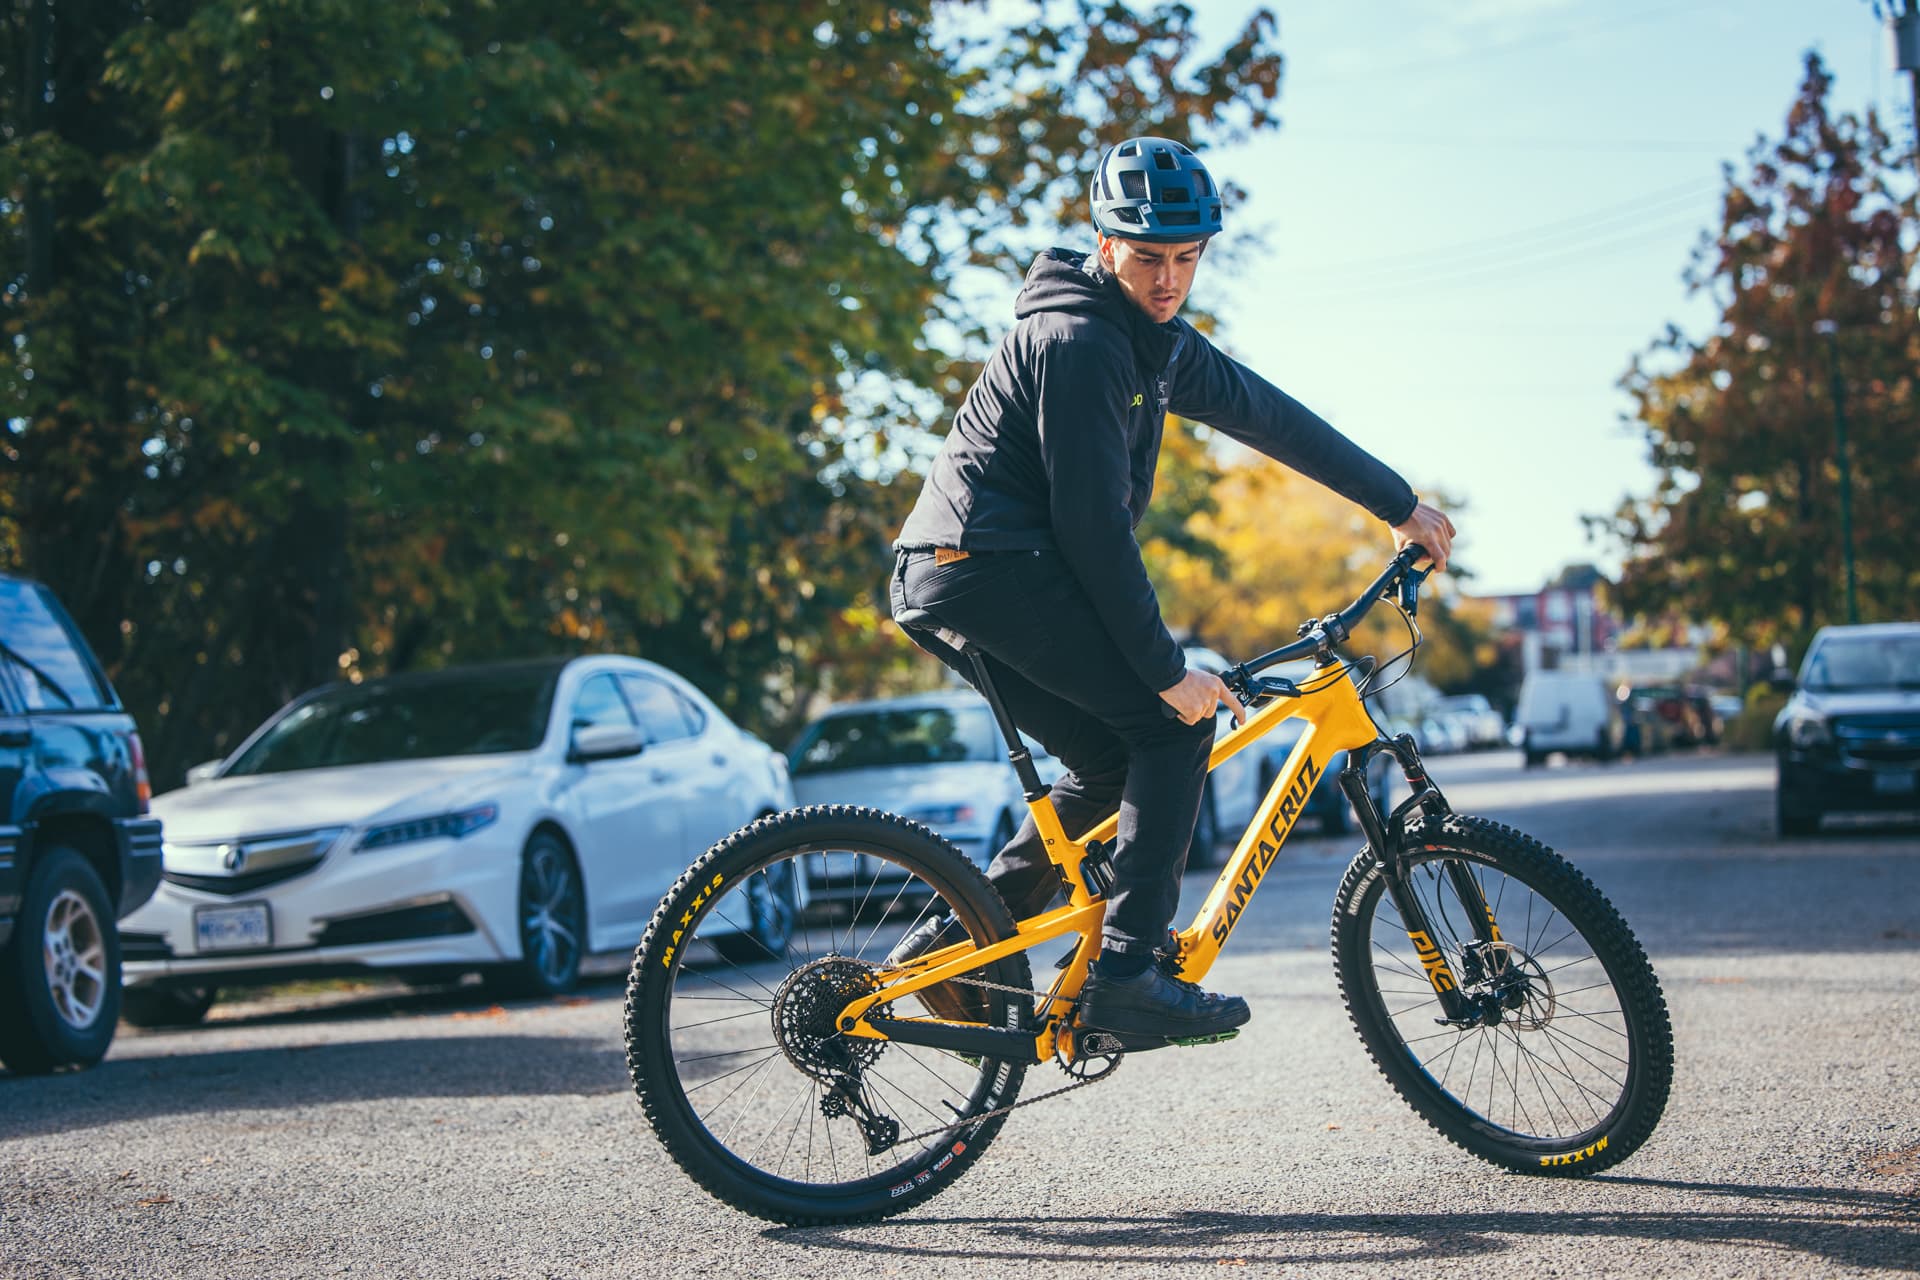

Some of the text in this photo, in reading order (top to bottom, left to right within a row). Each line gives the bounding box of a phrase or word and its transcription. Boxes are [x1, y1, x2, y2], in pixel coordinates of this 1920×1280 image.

[1213, 754, 1321, 948] SANTA CRUZ
[662, 873, 724, 968] MAXXIS
[1347, 878, 1371, 916] MINION
[1407, 931, 1457, 993] PIKE
[991, 1061, 1011, 1096] DHR
[1540, 1136, 1609, 1166] MAXXIS
